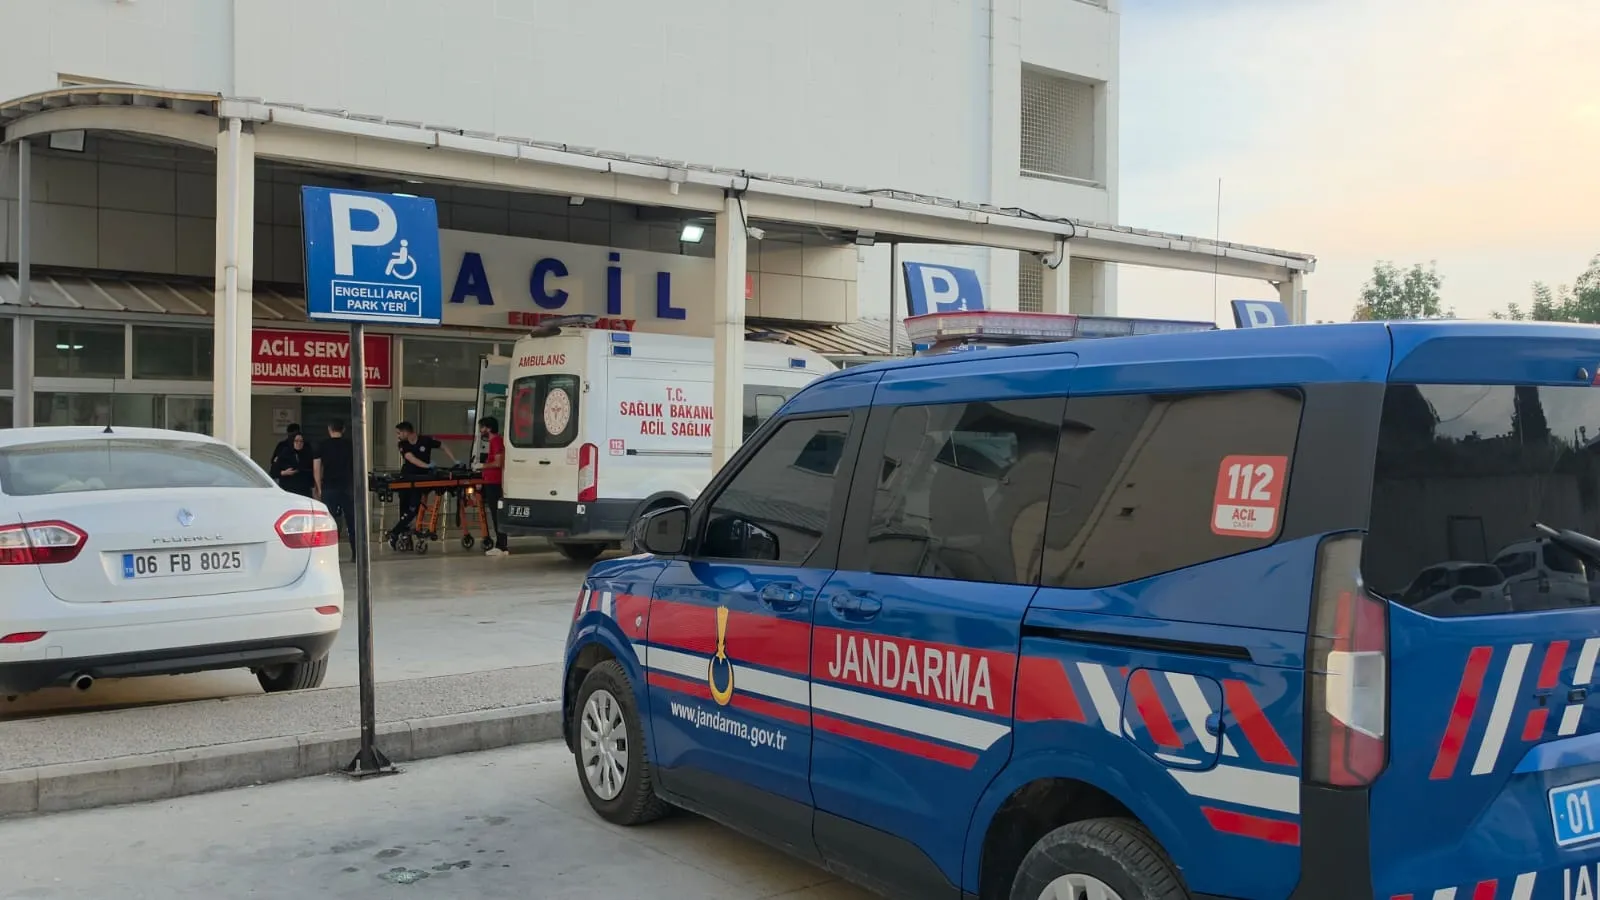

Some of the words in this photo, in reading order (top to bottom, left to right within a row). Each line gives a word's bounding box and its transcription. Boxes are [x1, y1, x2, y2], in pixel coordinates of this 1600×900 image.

[329, 193, 398, 276] P
[335, 286, 384, 299] ENGELLİ
[386, 290, 418, 303] ARAÇ
[449, 252, 686, 321] ACİL
[919, 266, 959, 314] P
[347, 299, 378, 311] PARK
[381, 301, 407, 312] YERİ
[258, 336, 300, 357] ACİL
[303, 340, 351, 359] SERV
[251, 362, 310, 378] BULANSLA
[312, 364, 346, 379] GELEN
[518, 353, 566, 368] AMBULANS
[666, 387, 687, 402] T.C.
[620, 400, 663, 418] SAĞLIK
[640, 419, 666, 436] ACİL
[671, 421, 711, 437] SAĞLIK
[1228, 463, 1274, 501] 112
[135, 555, 158, 574] 06
[170, 553, 192, 572] FB
[200, 551, 241, 570] 8025
[828, 633, 995, 710] JANDARMA
[670, 700, 788, 751] www.jandarma.gov.tr
[1566, 790, 1594, 834] 01
